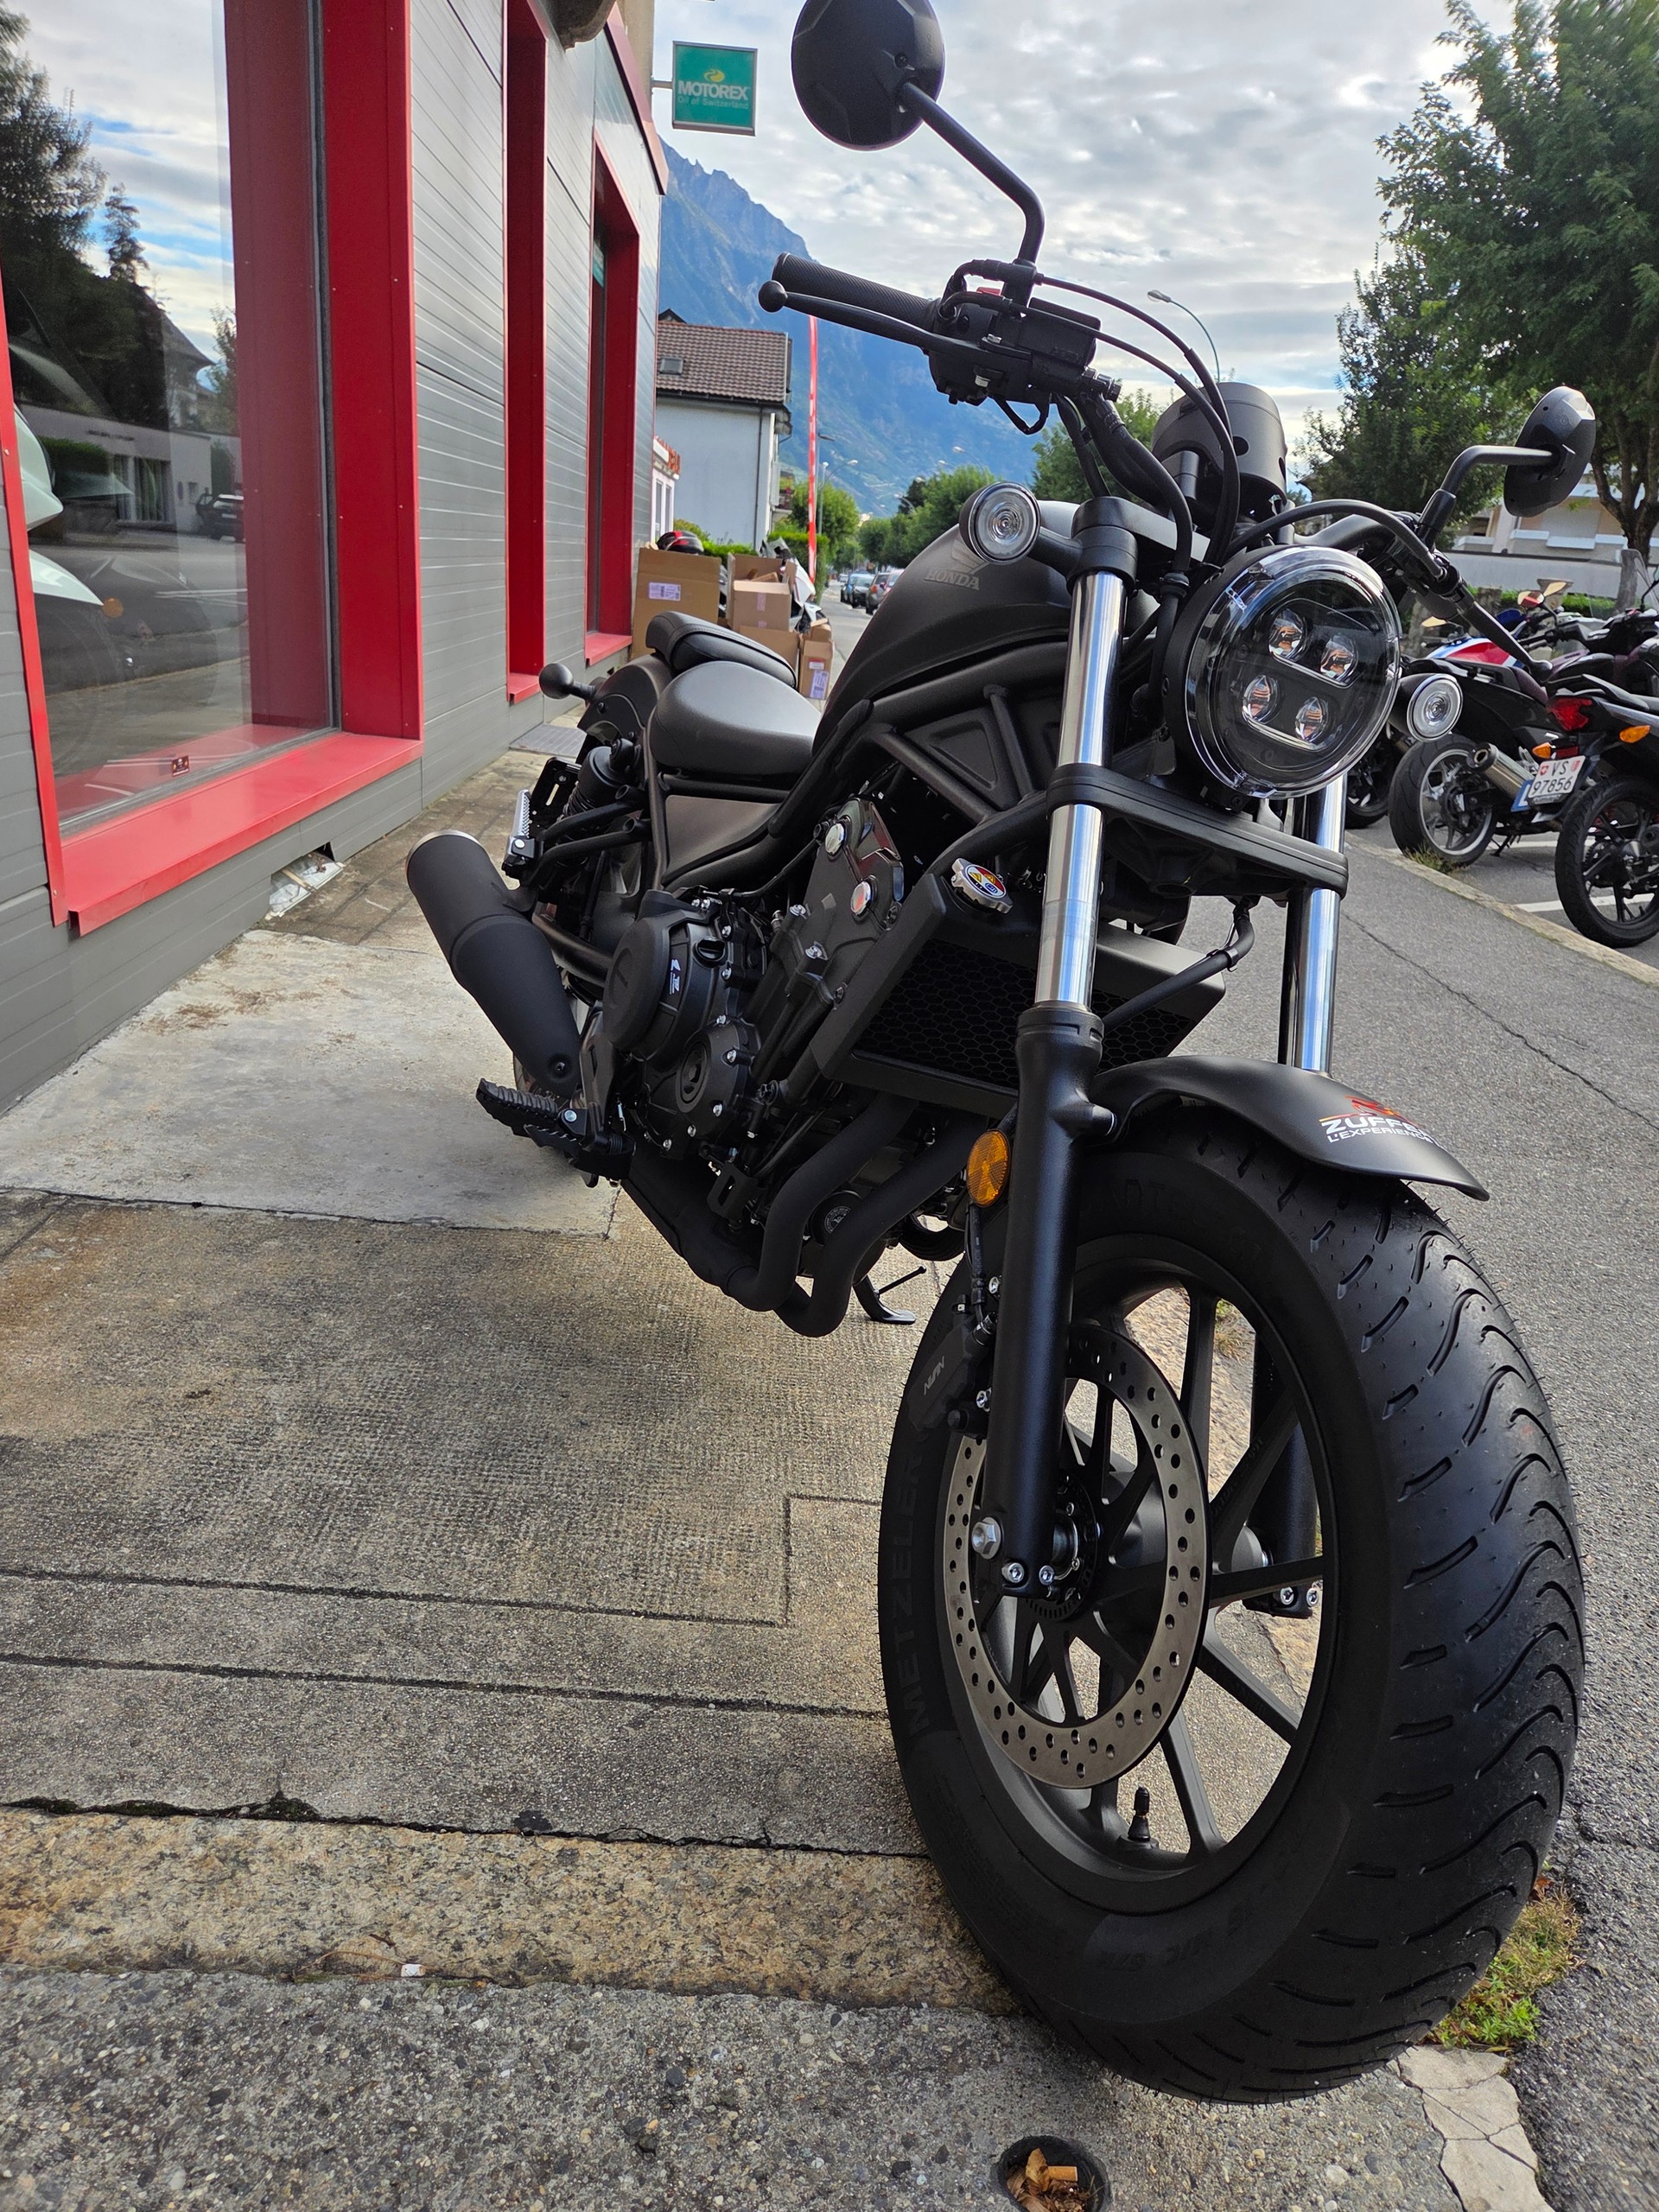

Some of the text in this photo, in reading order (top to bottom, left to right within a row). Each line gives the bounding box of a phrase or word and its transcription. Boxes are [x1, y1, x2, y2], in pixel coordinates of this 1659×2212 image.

[677, 80, 749, 100] MOTOREX
[677, 95, 690, 104] Oil
[702, 98, 749, 110] Switzerland
[924, 569, 981, 590] HONDA
[1551, 761, 1568, 776] VS
[1532, 776, 1573, 795] 97856
